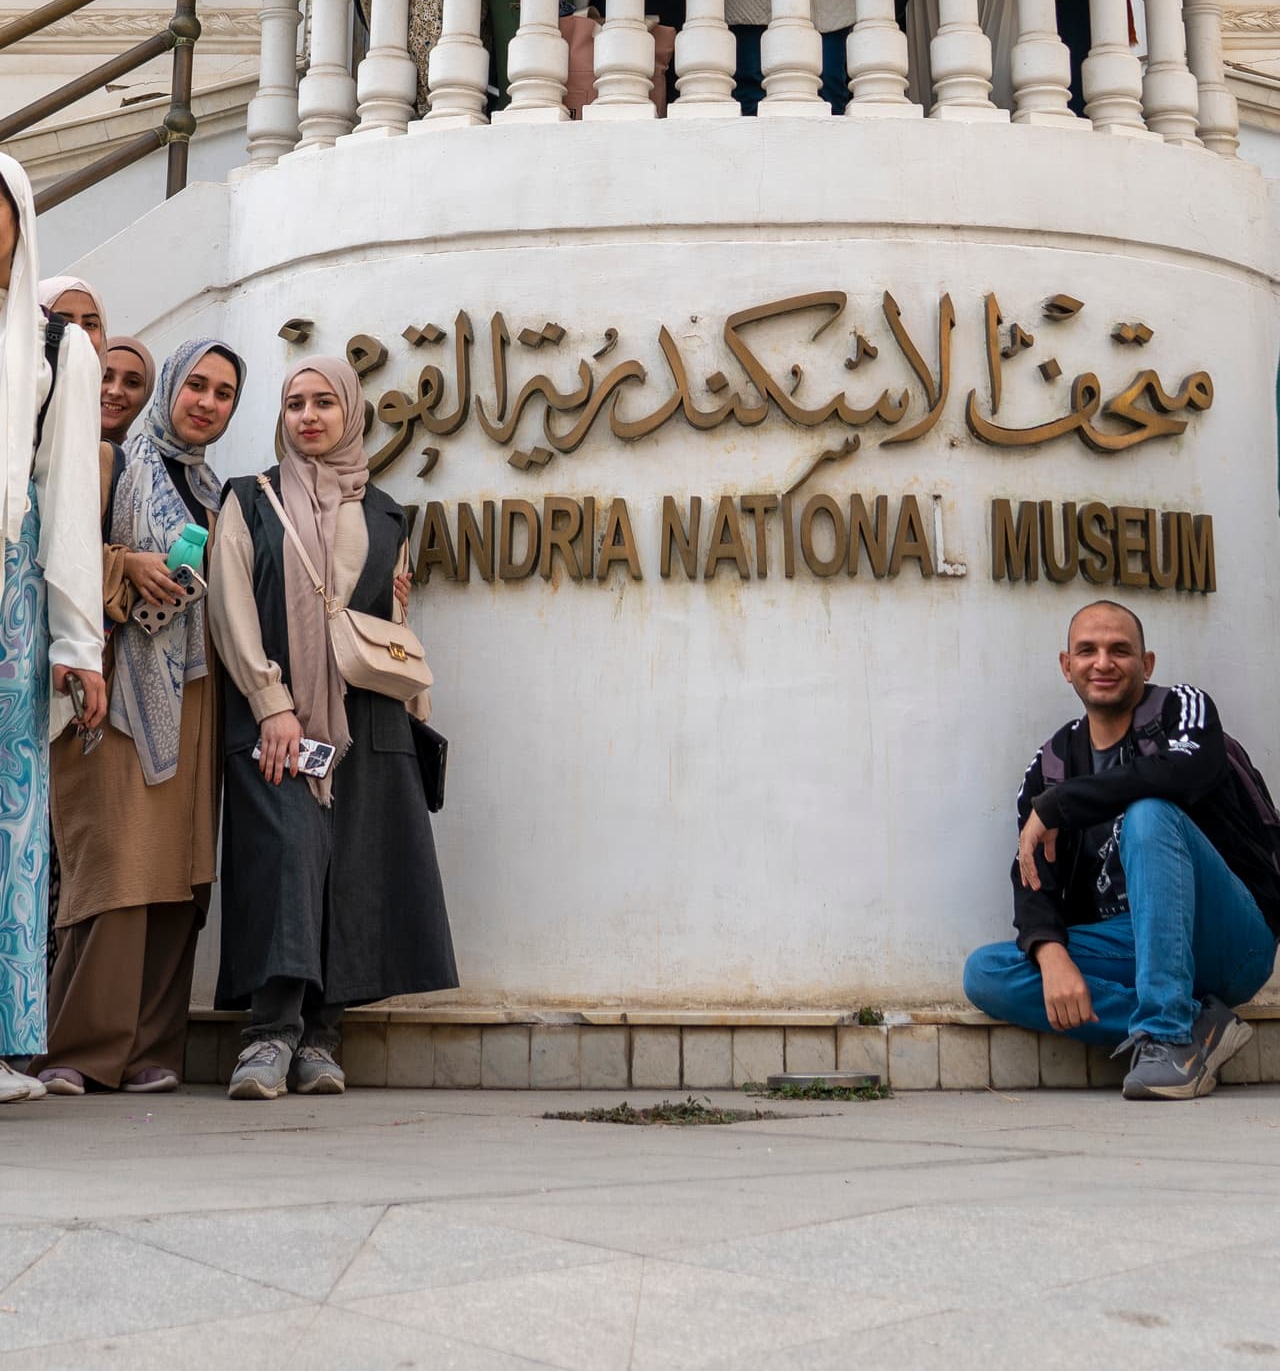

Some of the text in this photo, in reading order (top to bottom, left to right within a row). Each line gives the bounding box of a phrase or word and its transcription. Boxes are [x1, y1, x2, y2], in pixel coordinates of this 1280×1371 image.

[966, 293, 1214, 453] متحف
[403, 493, 1217, 594] ANDRIA NATIONAL MUSEUM
